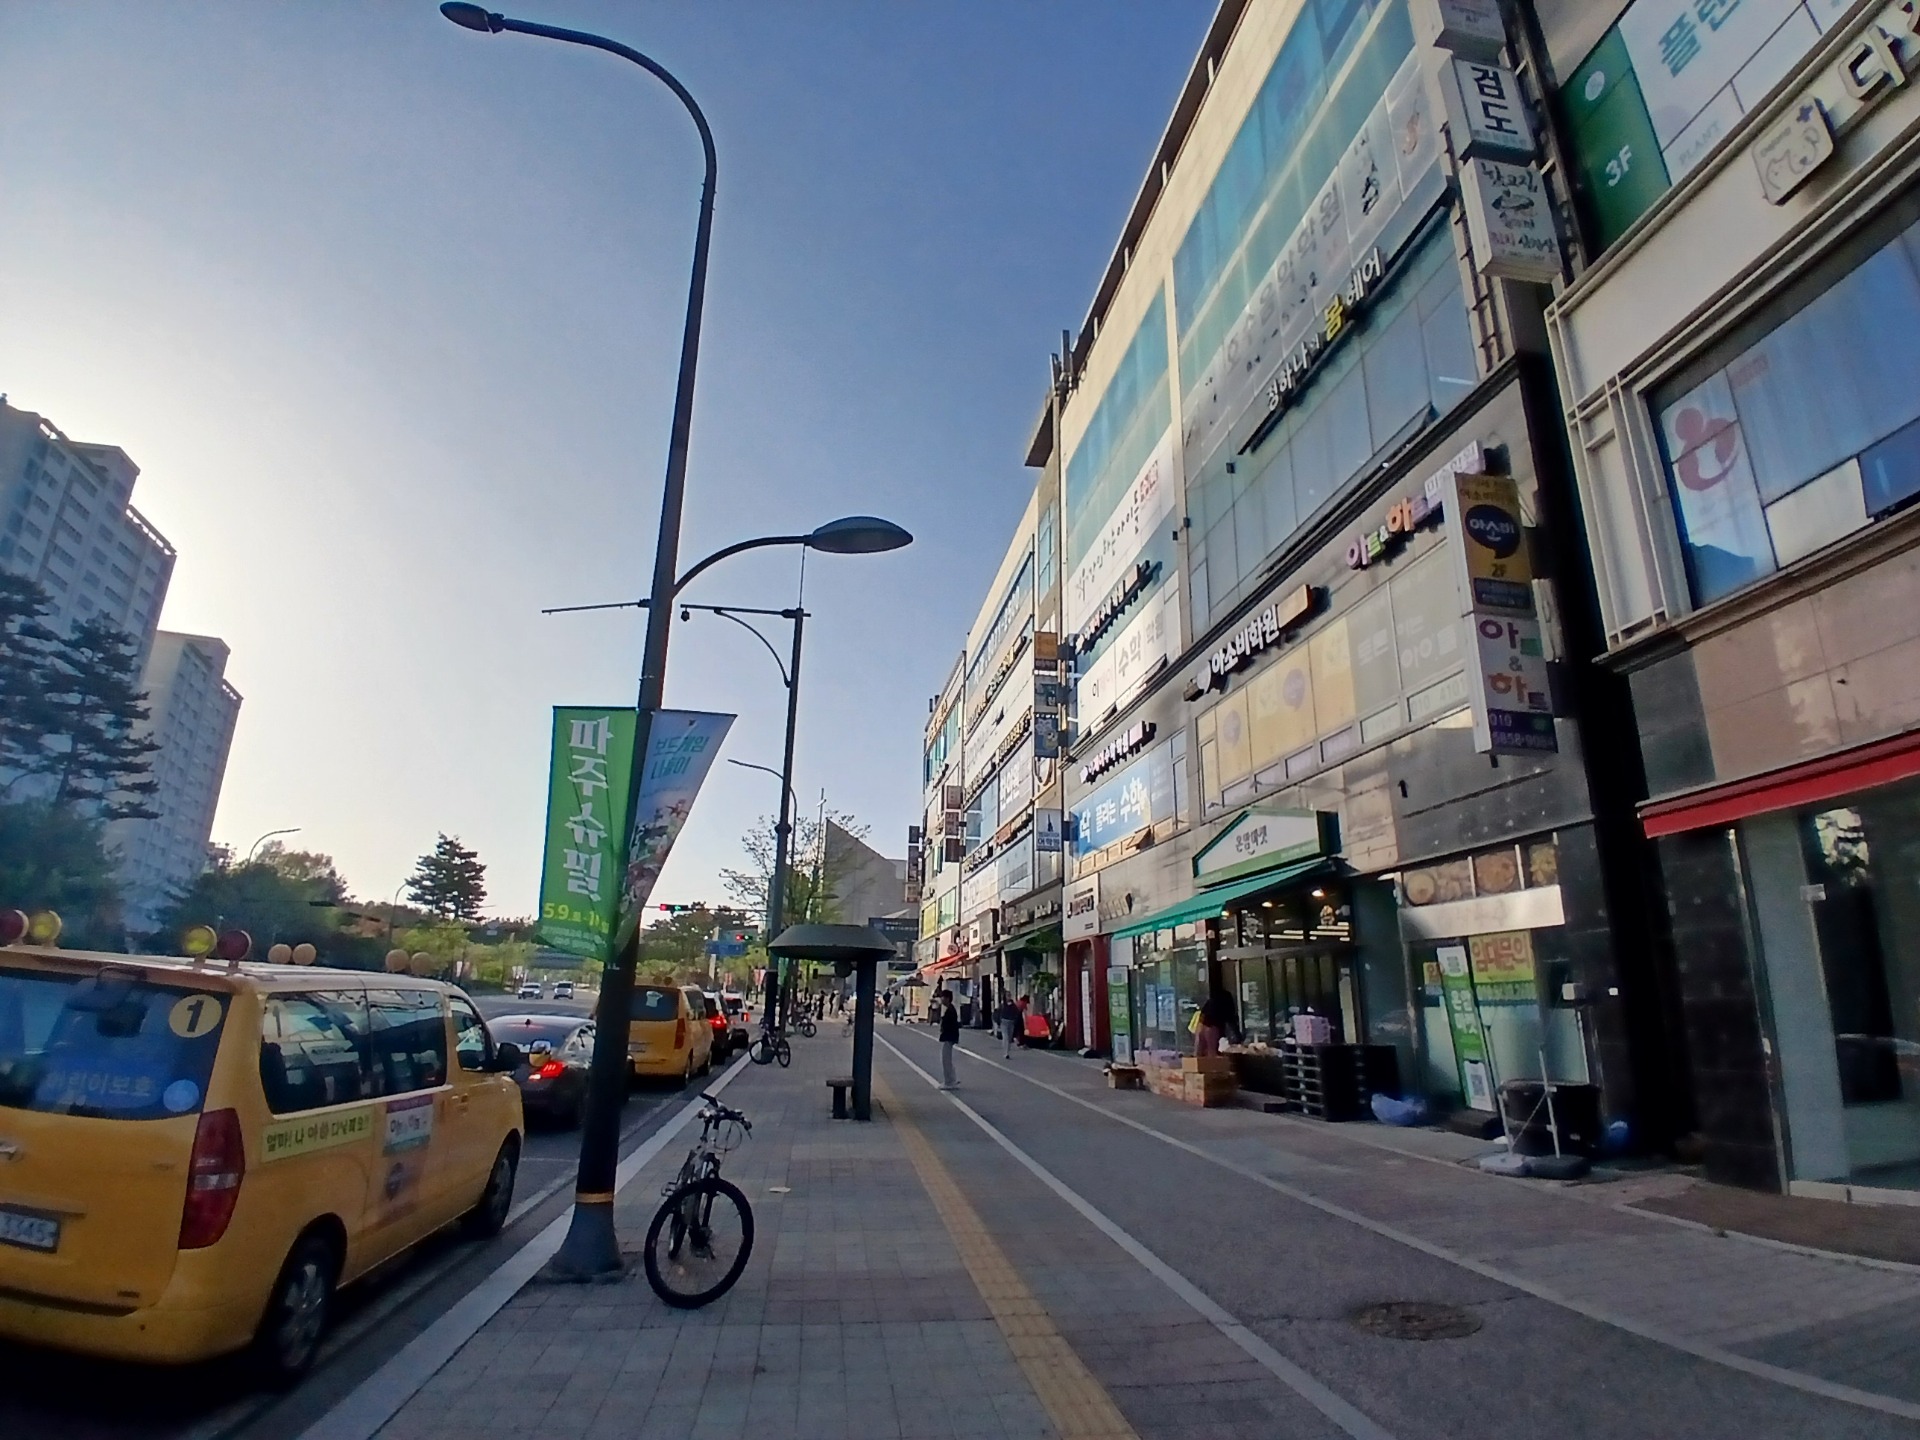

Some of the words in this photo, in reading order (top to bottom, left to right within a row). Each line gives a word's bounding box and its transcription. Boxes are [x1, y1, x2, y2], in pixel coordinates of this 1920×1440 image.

[1471, 66, 1518, 135] 검도
[1605, 145, 1634, 188] 3F
[1346, 246, 1382, 306] 헤어
[1211, 603, 1280, 676] 아소비학원
[187, 1000, 204, 1033] 1
